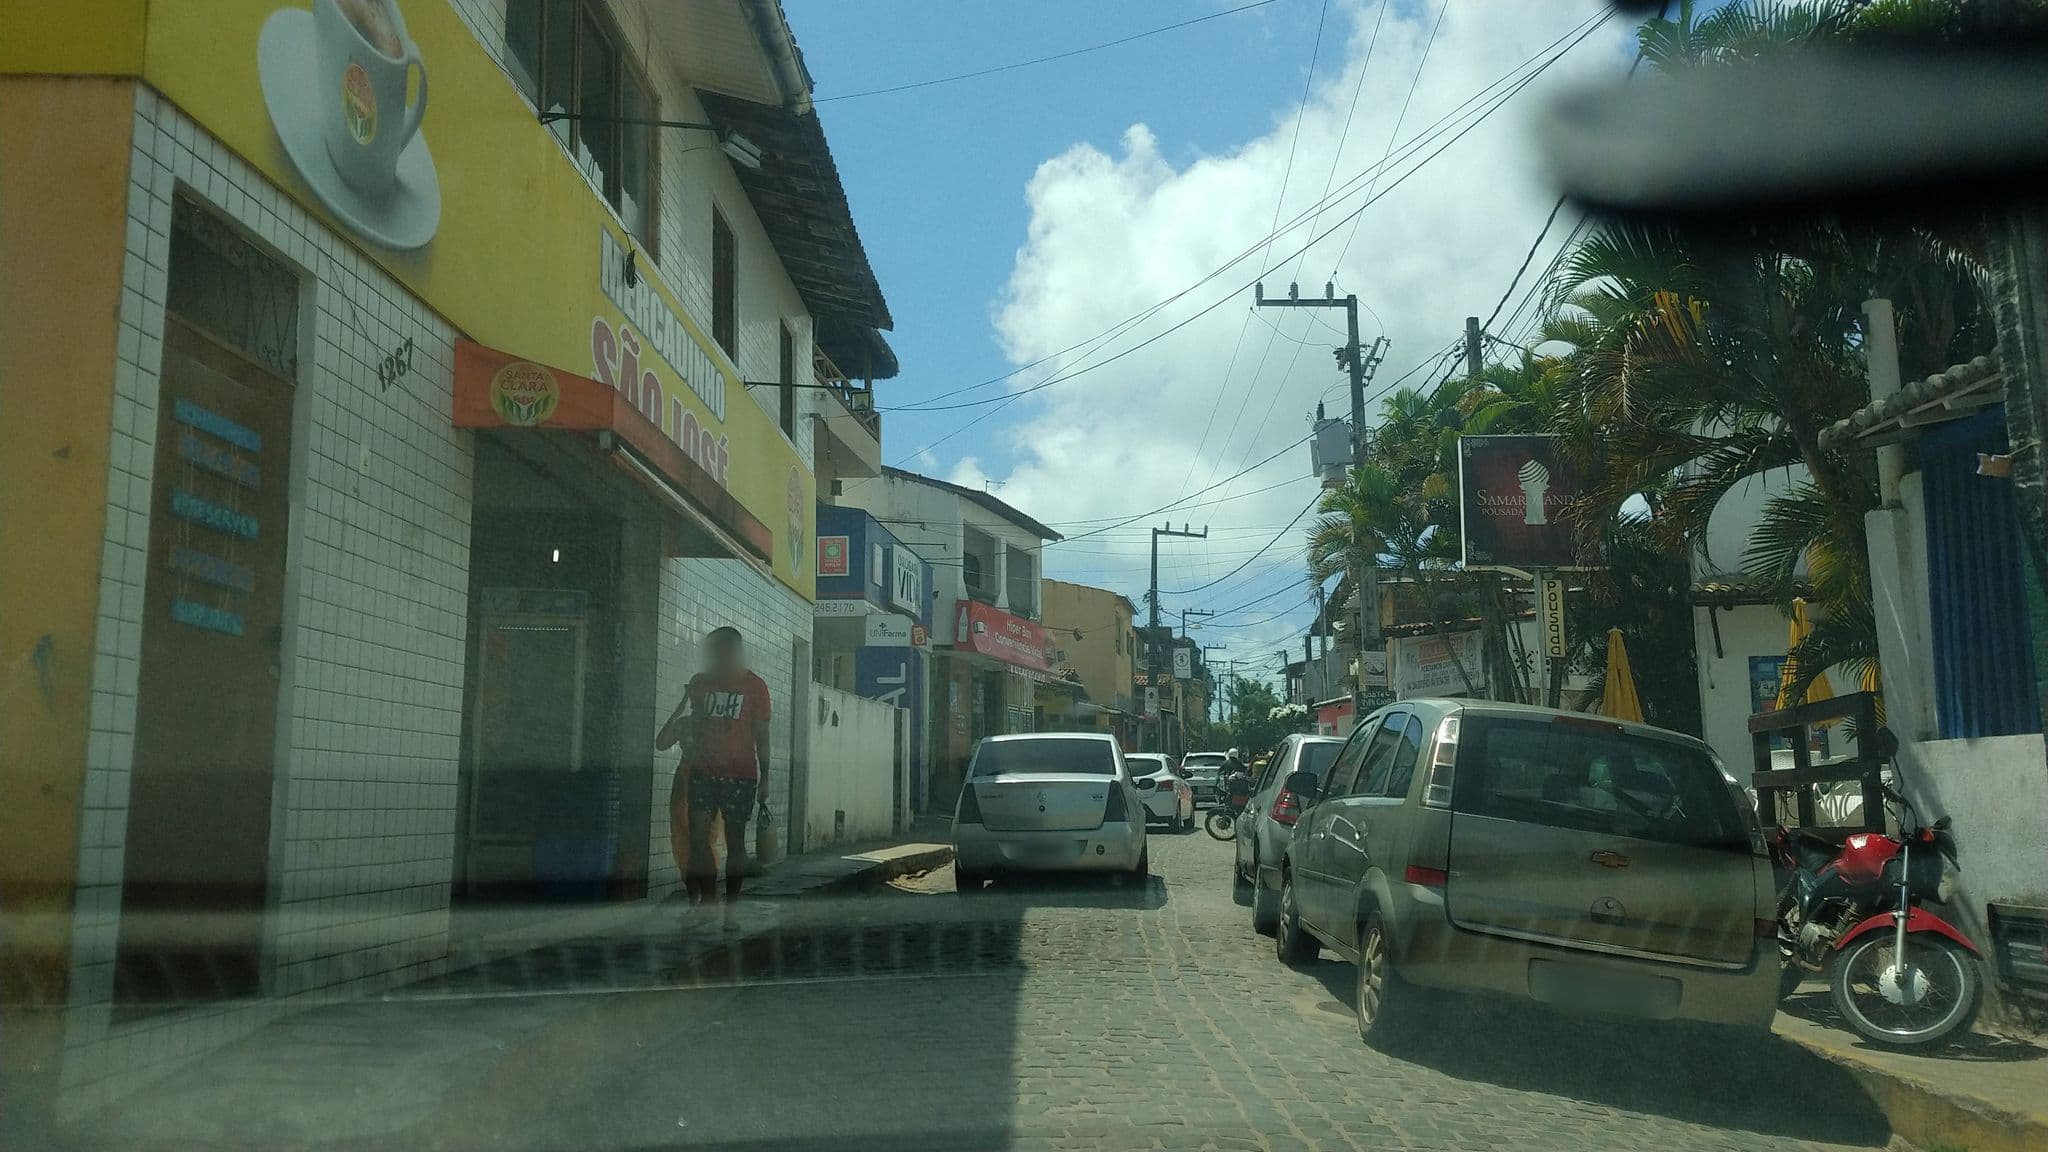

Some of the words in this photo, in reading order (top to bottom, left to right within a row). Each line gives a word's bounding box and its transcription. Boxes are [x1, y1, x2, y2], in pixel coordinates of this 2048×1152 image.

[600, 226, 726, 424] MERCADINHO
[377, 337, 415, 393] 1267
[506, 369, 544, 381] SANTA
[591, 316, 664, 433] SÃO
[500, 379, 549, 392] CLARA
[1481, 508, 1525, 517] POUSADA
[706, 692, 740, 719] Duff
